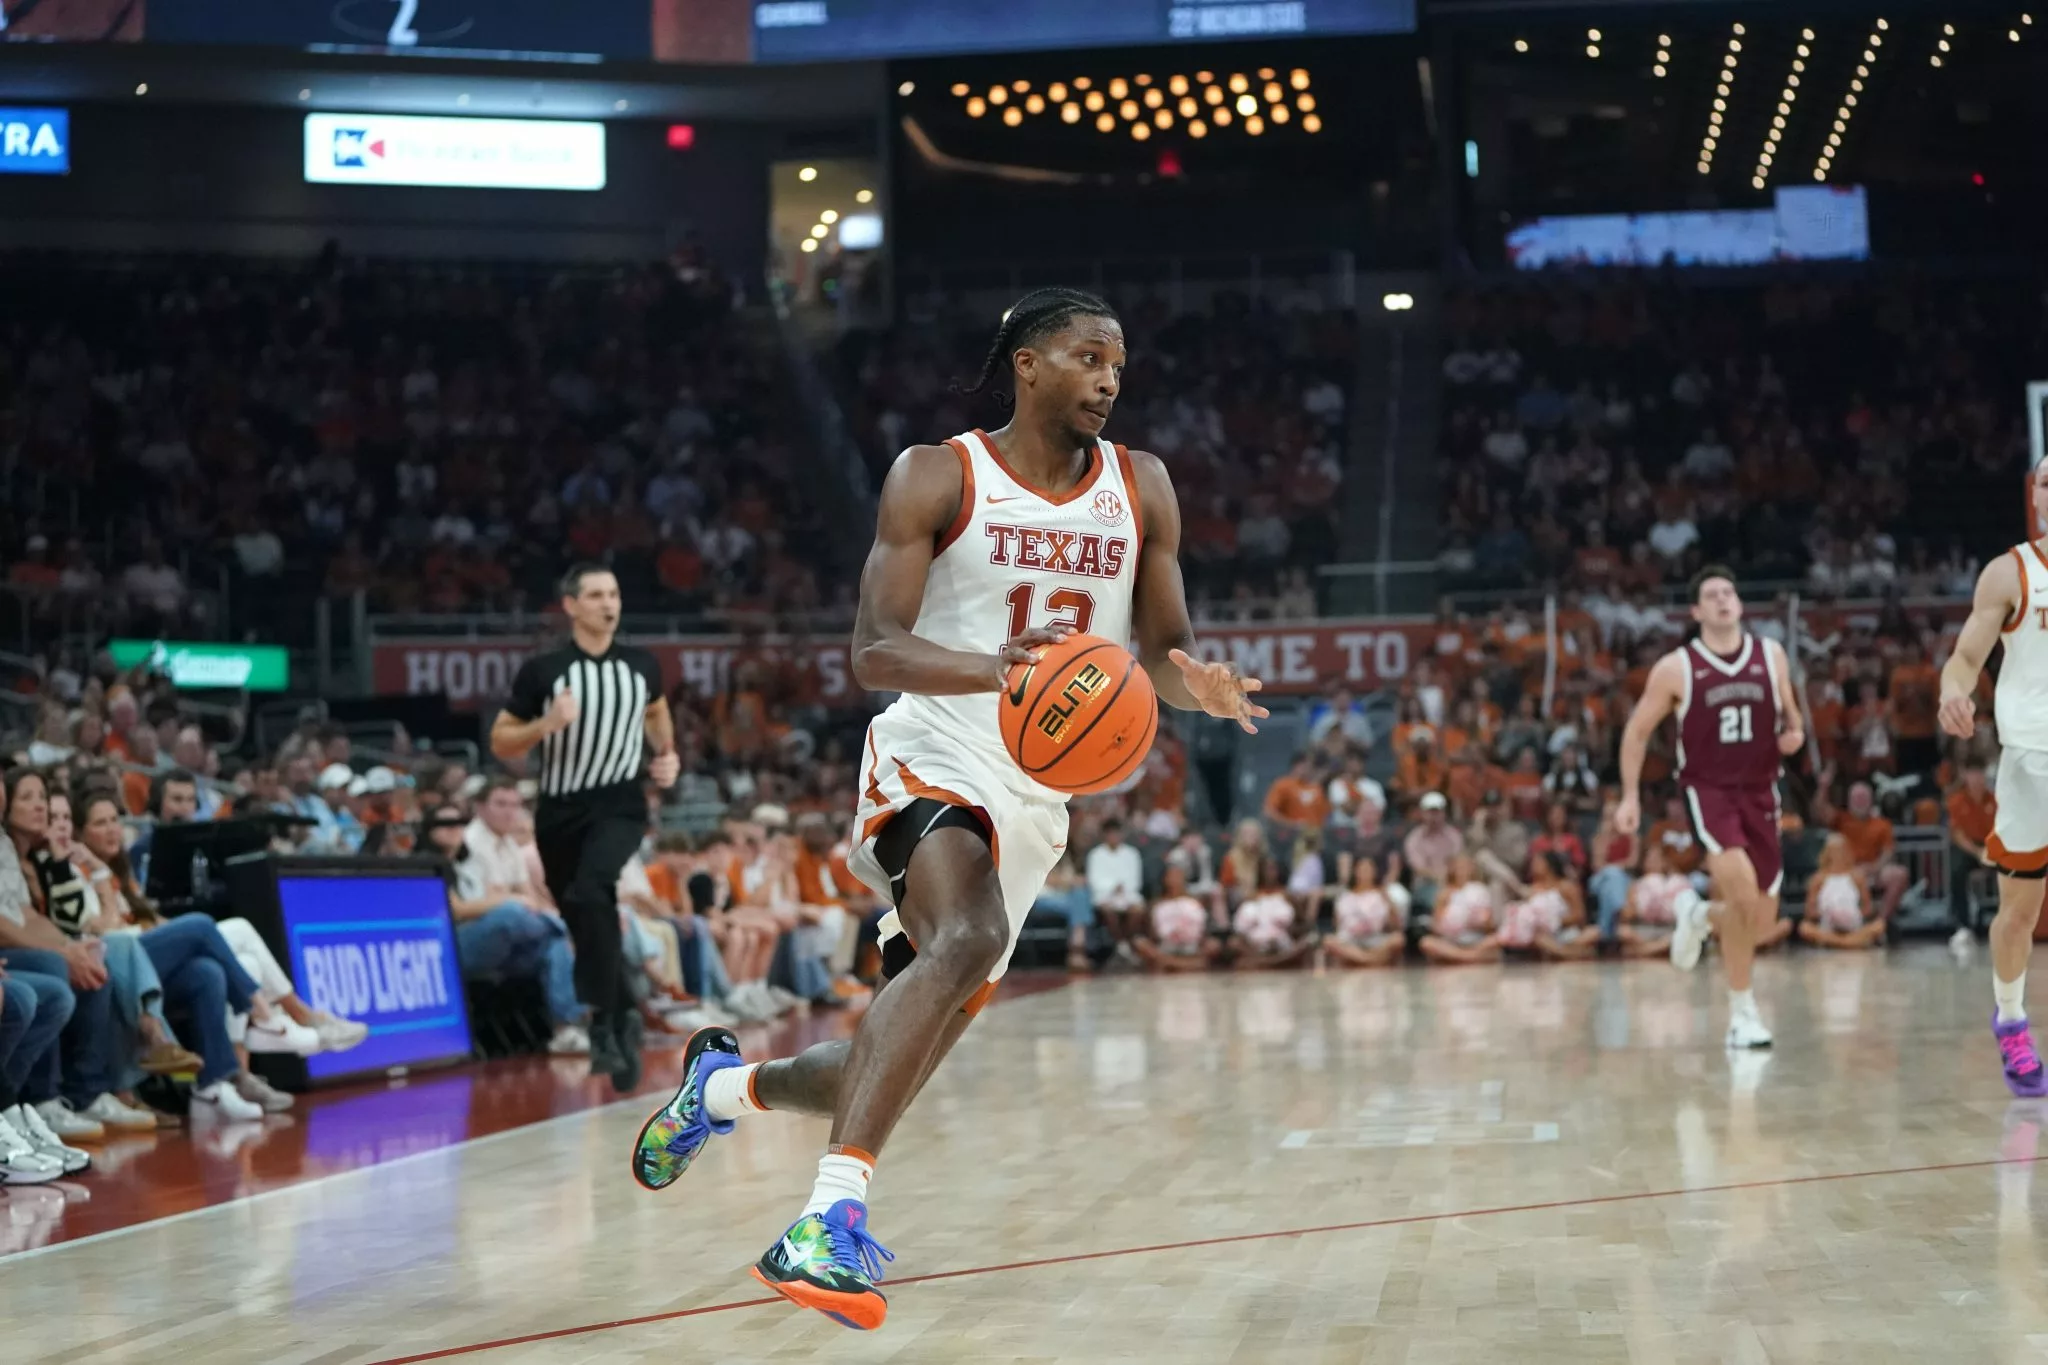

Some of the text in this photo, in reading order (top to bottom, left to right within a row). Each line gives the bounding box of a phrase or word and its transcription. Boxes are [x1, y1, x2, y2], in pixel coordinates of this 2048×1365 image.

[0, 121, 61, 157] RA
[1095, 491, 1121, 518] SEC
[985, 522, 1128, 579] TEXAS
[1336, 630, 1408, 681] TO
[1036, 660, 1107, 741] ELITE
[1718, 704, 1754, 744] 21
[303, 940, 448, 1016] BUD LIGHT
